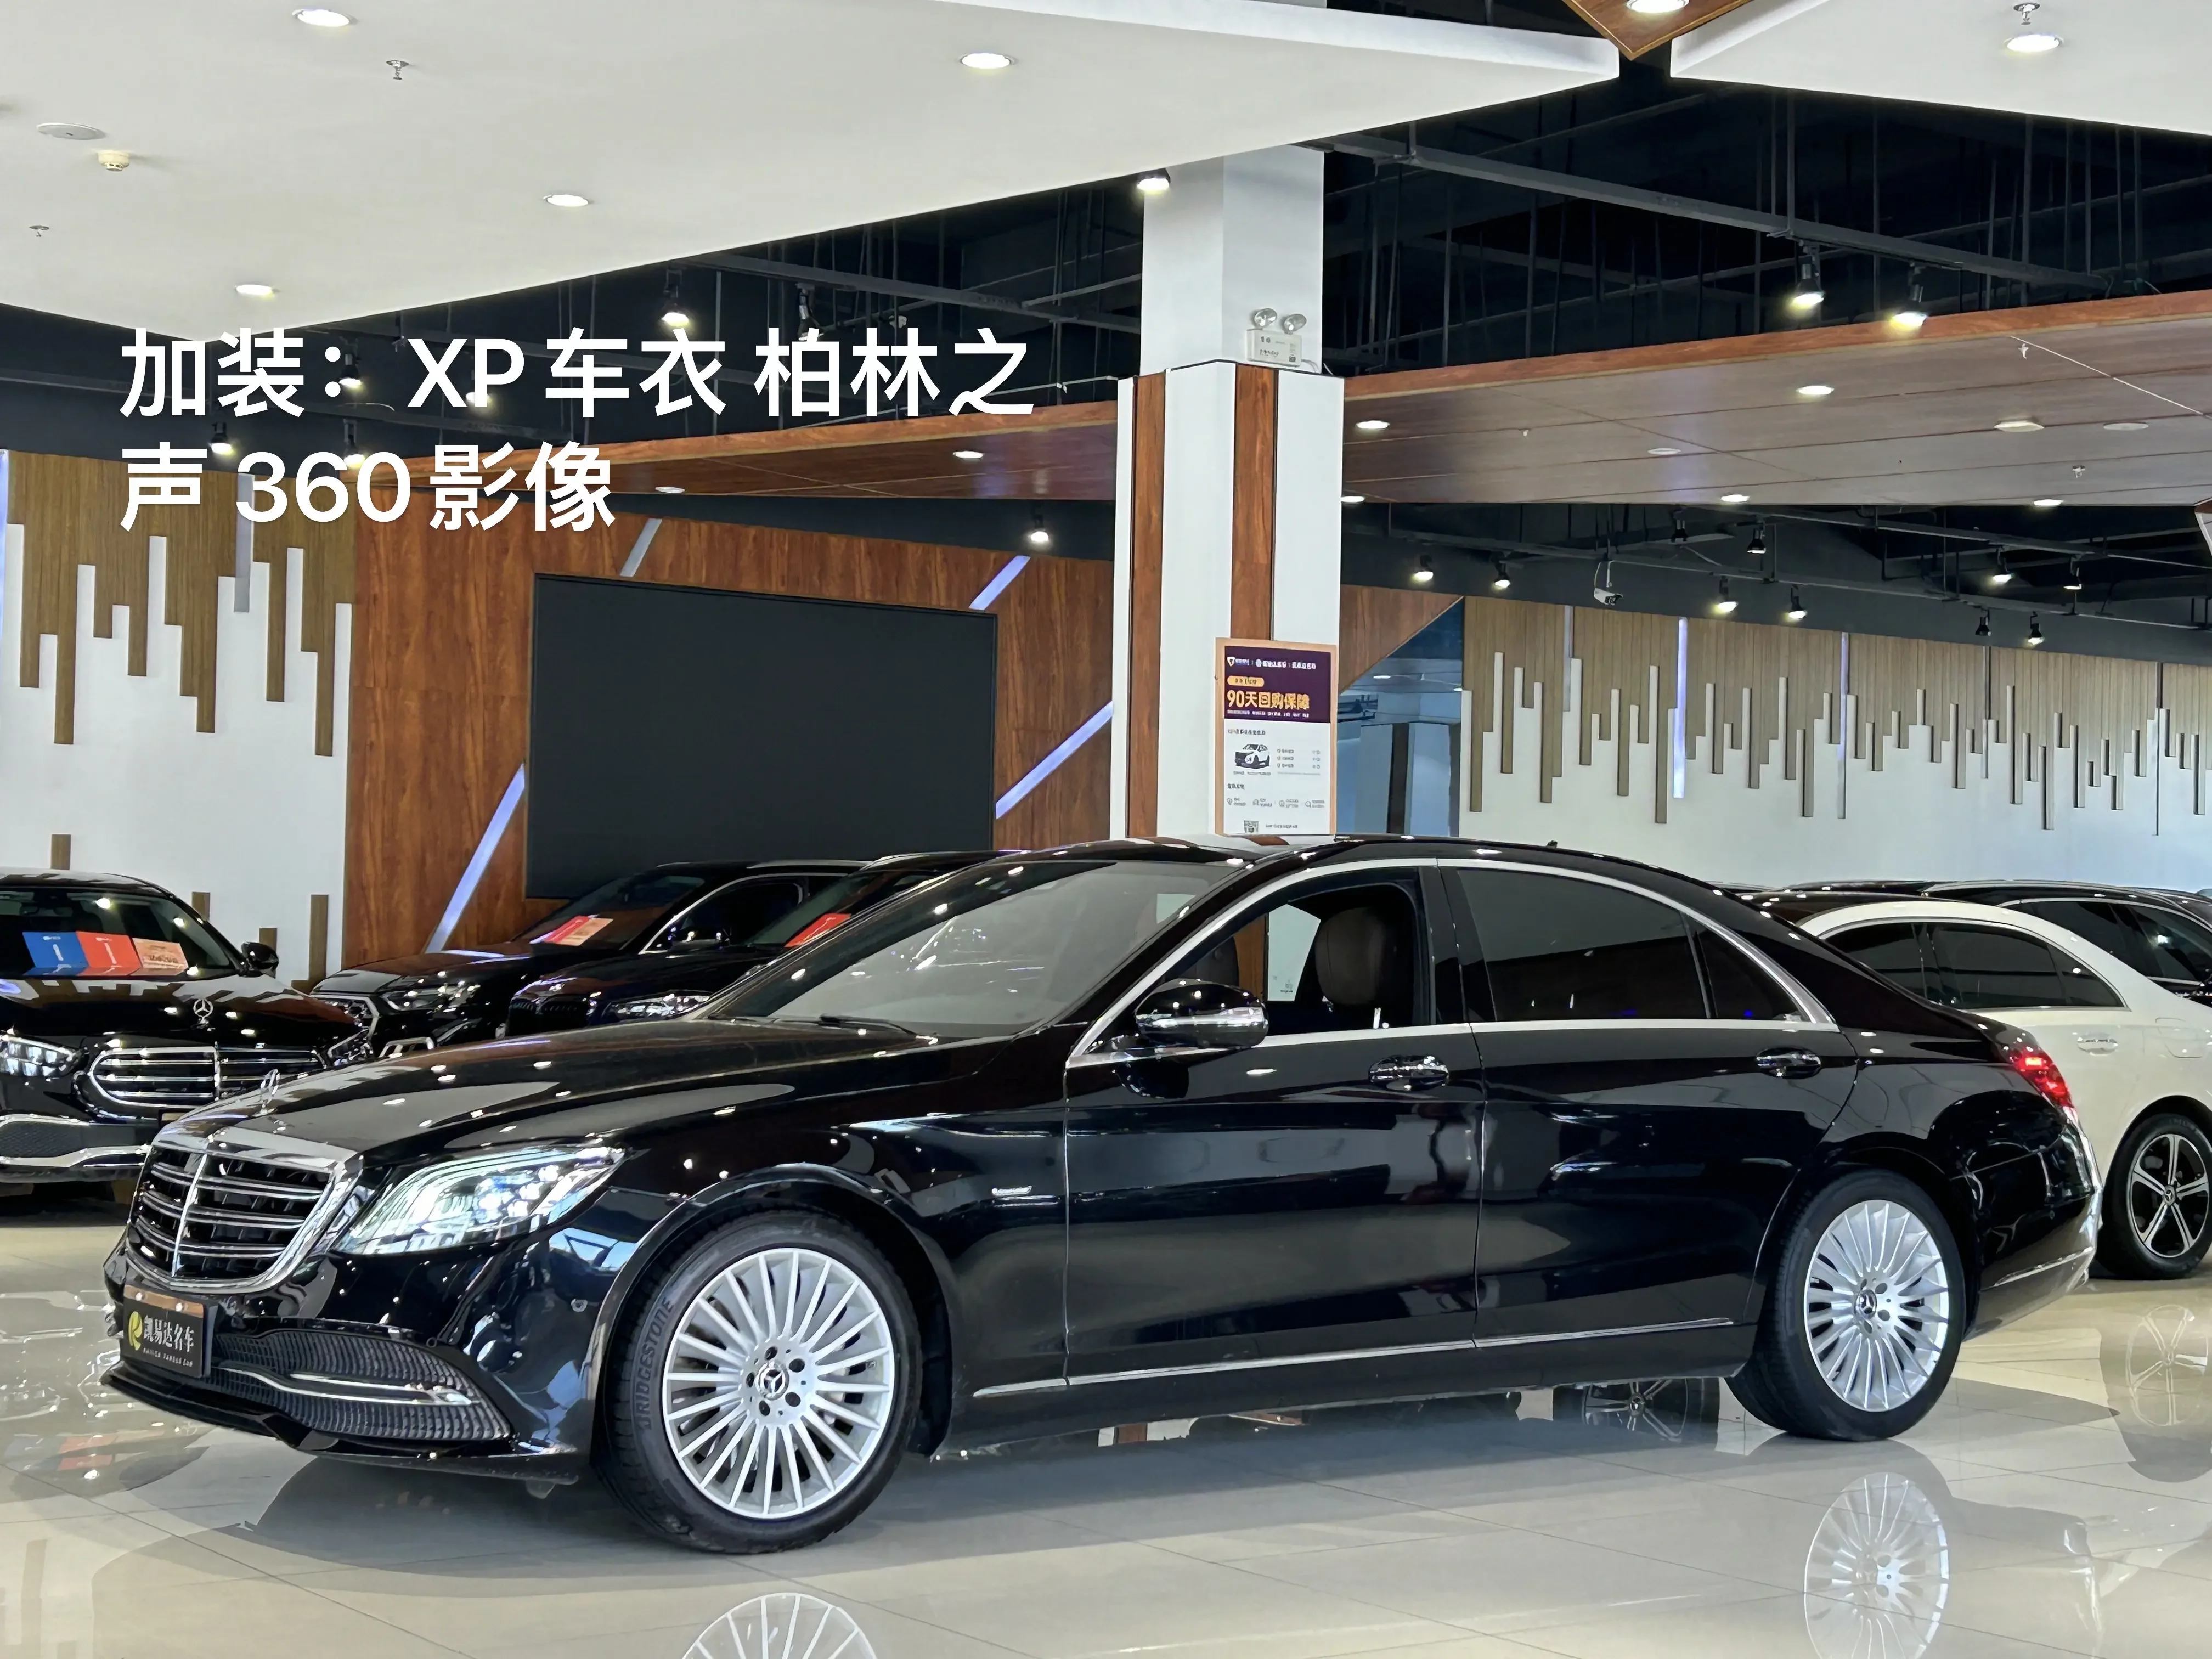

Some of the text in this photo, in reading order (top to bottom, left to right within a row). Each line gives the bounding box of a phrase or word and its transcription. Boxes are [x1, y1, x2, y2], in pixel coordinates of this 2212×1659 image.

[1227, 689, 1310, 710] 90天回购保障
